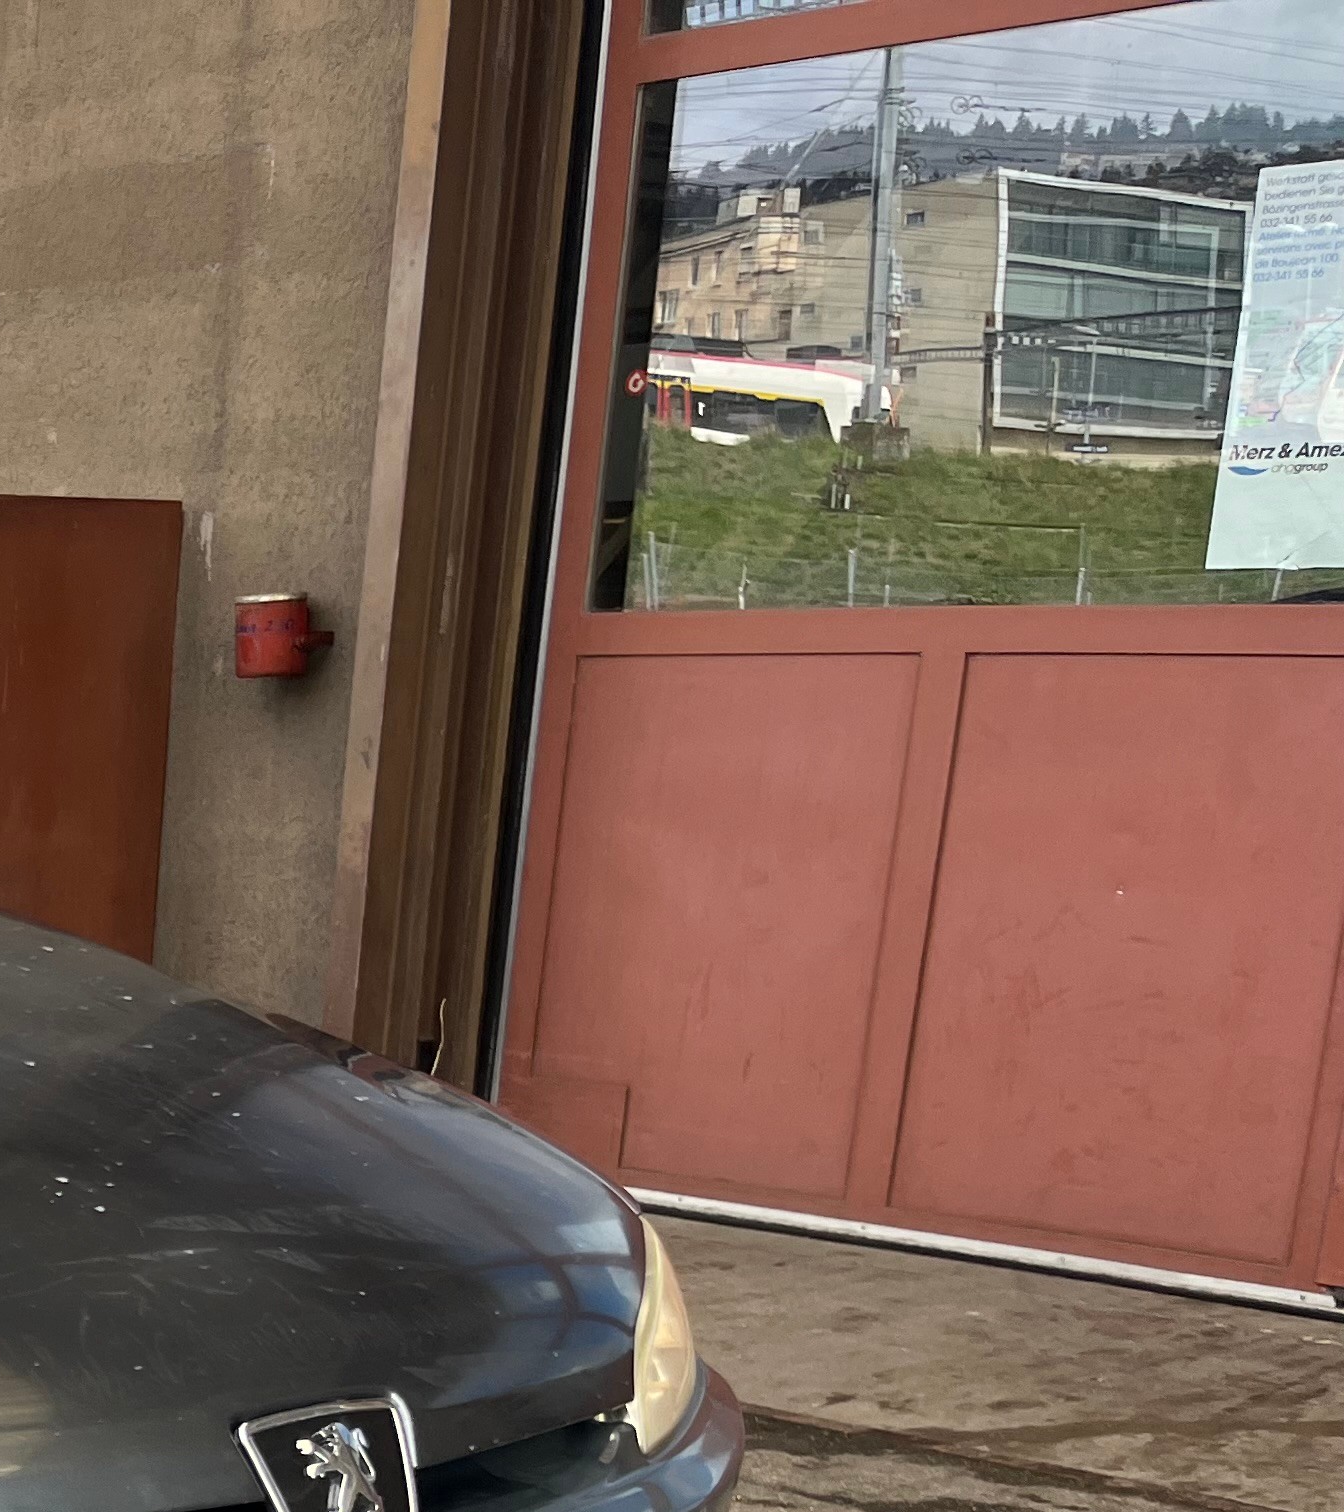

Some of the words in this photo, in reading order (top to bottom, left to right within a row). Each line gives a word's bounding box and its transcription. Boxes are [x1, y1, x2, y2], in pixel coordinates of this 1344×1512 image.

[1304, 213, 1317, 224] 55
[1319, 213, 1333, 222] 66
[1229, 444, 1276, 460] Merz
[1278, 442, 1293, 459] &
